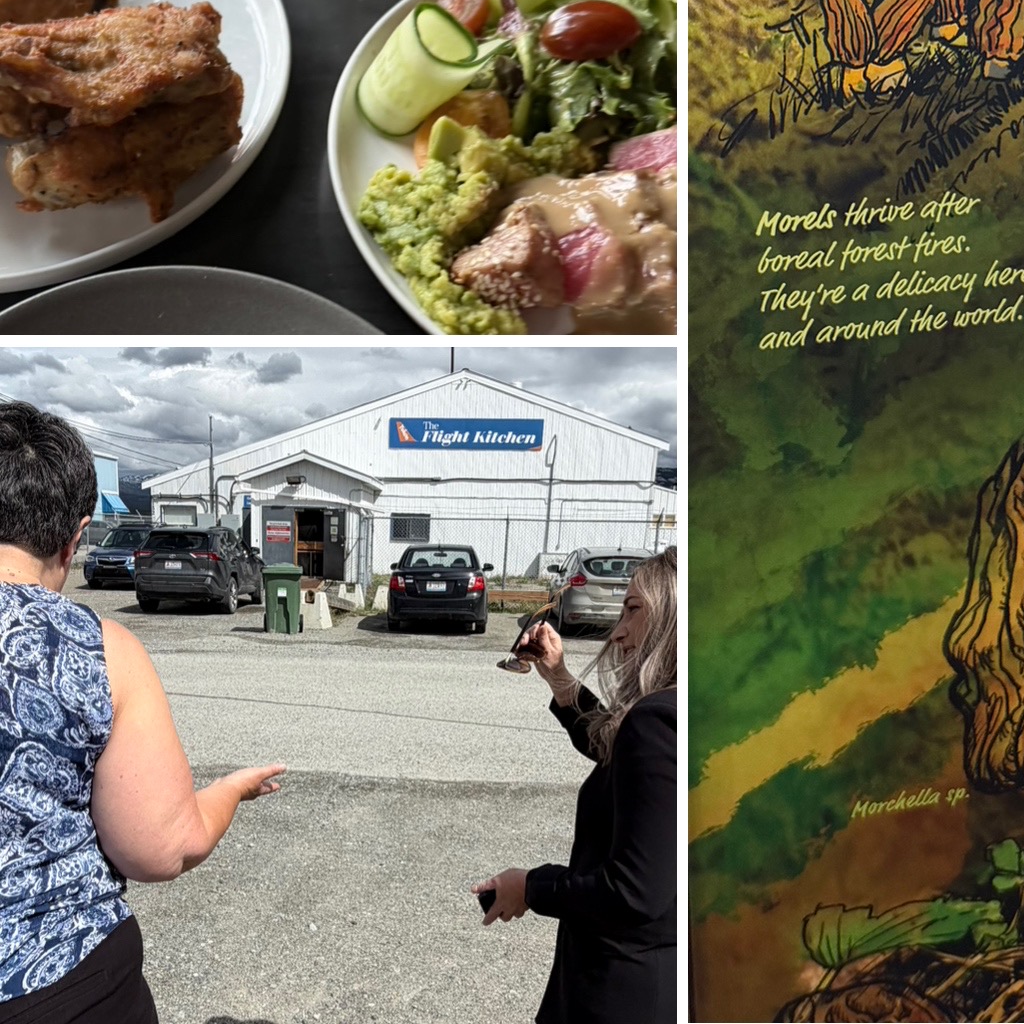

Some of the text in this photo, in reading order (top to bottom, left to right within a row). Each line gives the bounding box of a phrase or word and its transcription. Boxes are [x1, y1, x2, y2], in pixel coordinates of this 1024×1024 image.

[755, 191, 981, 237] Morels thrive after
[758, 231, 971, 274] boreal forest fires.
[760, 283, 847, 321] They're
[851, 284, 870, 301] a
[875, 270, 977, 303] delicacy
[759, 294, 1024, 350] and around the world.
[421, 430, 470, 447] Flight
[473, 430, 537, 445] Kitchen
[422, 421, 440, 430] The
[851, 787, 970, 818] Morchella sp.
